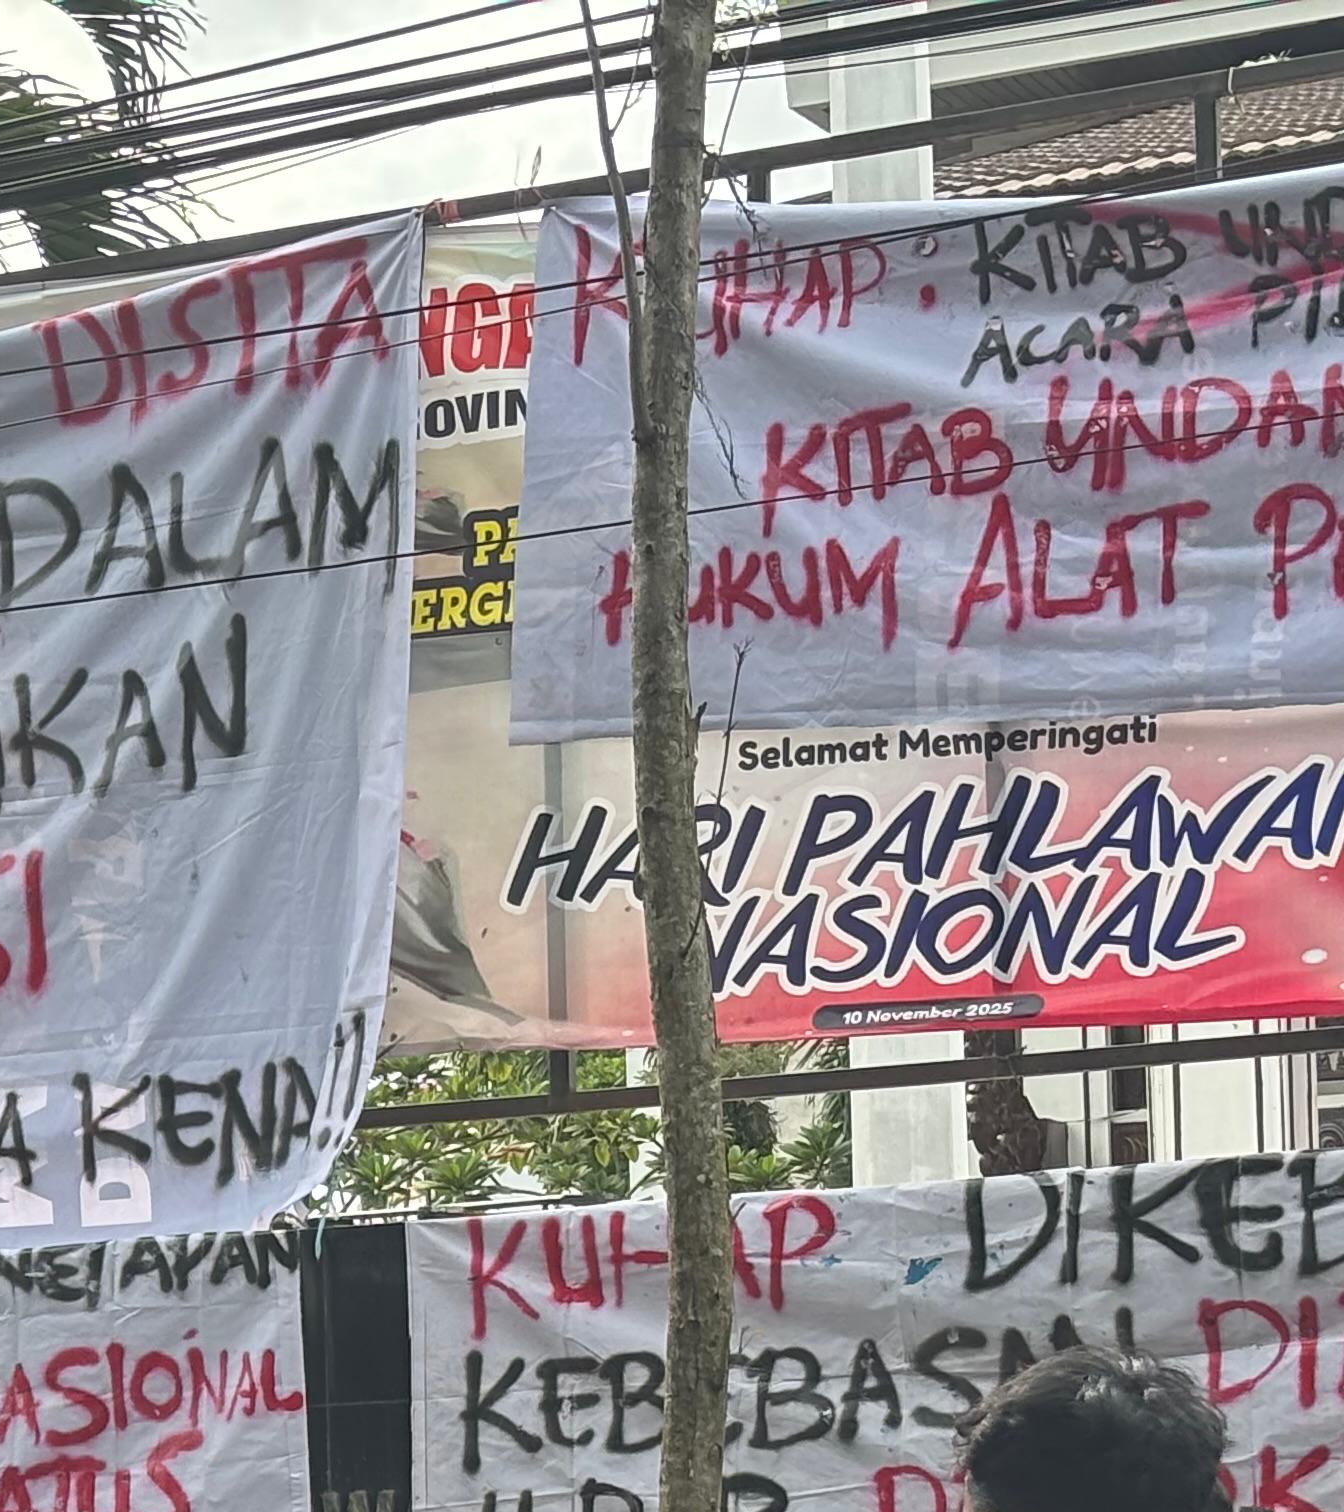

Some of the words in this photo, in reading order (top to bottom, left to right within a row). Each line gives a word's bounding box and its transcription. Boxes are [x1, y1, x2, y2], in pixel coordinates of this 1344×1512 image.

[969, 207, 1190, 308] KITAB
[960, 290, 1197, 387] ACARA
[760, 400, 1016, 538] KITAB
[948, 491, 1211, 650] ALAT
[737, 732, 888, 771] Selamat
[898, 713, 1159, 764] Memperingati
[842, 1010, 862, 1025] 10
[866, 1006, 962, 1023] November
[964, 1001, 1013, 1017] 2025
